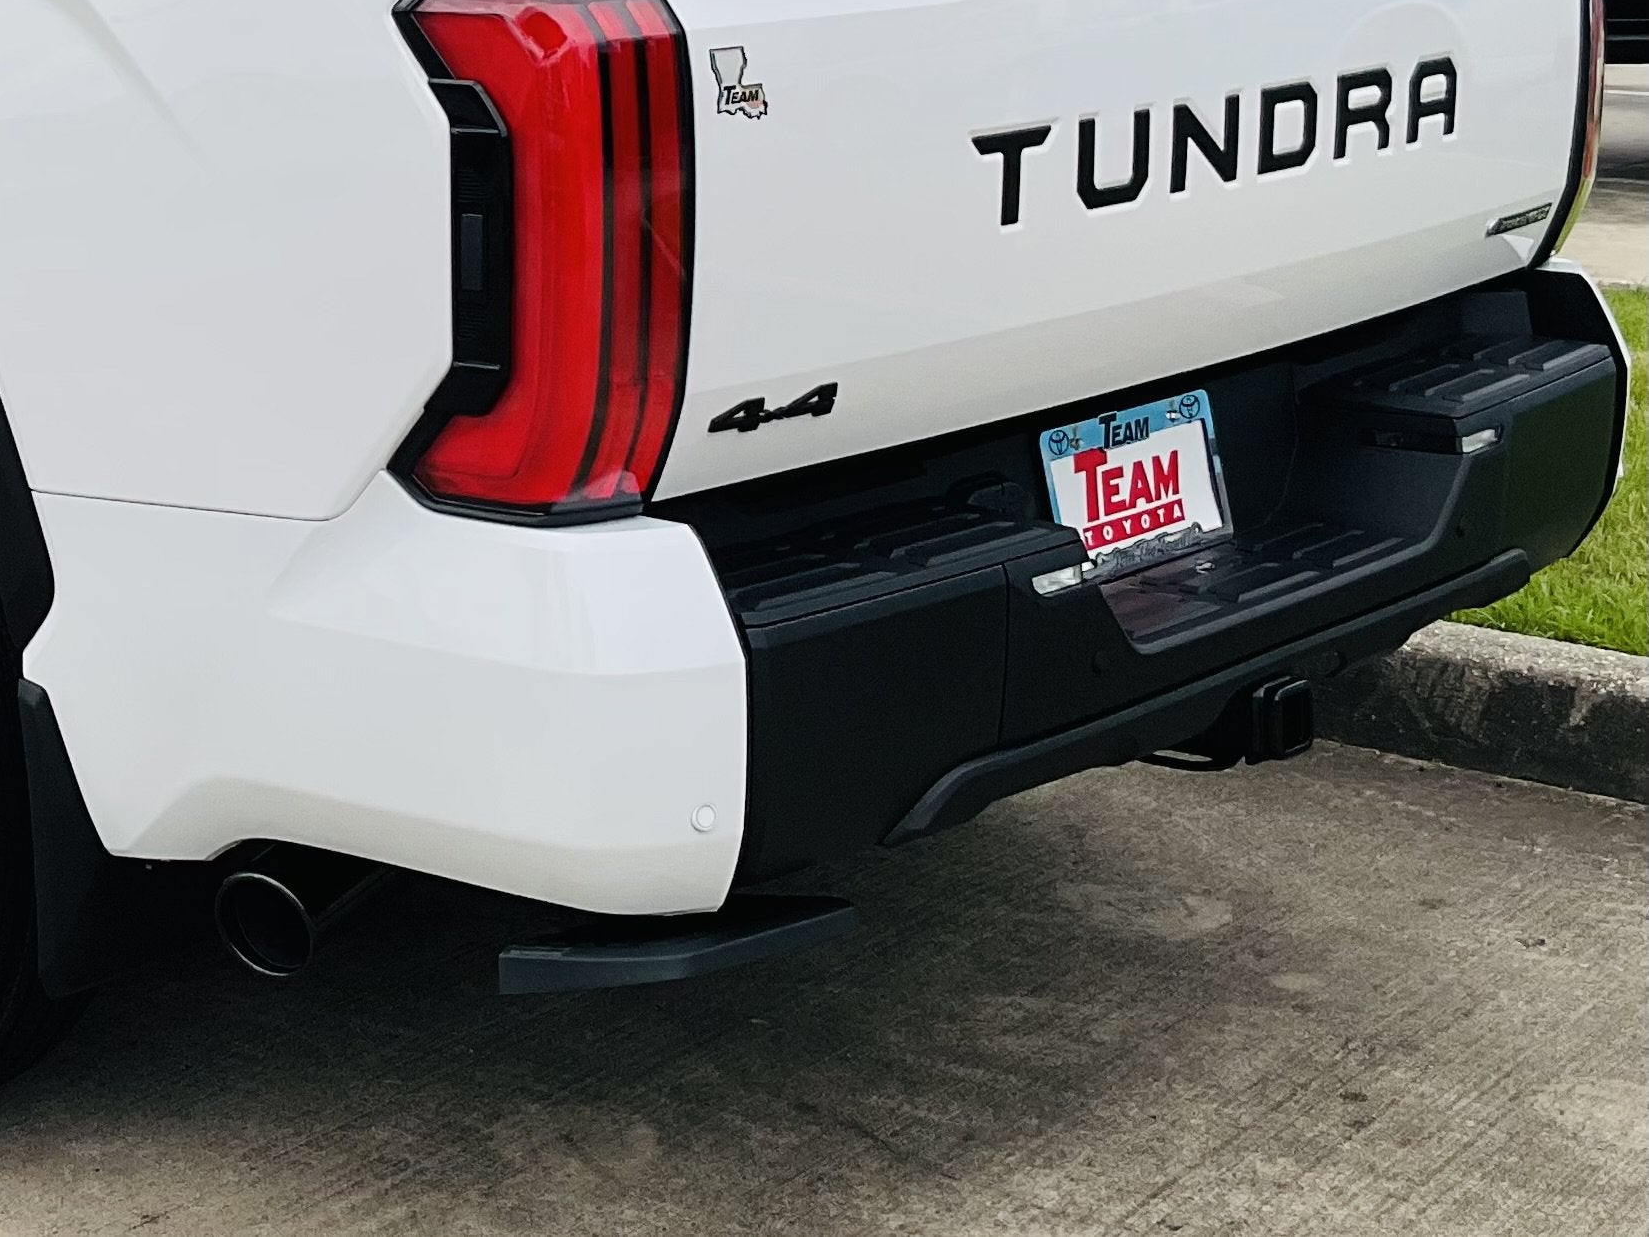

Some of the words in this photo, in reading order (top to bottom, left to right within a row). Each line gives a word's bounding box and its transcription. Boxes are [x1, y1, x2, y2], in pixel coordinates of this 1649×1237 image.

[722, 84, 760, 106] TEAM
[970, 55, 1458, 227] TUNDRA
[1098, 411, 1151, 450] TEAM
[1072, 447, 1181, 524] TEAM
[1083, 503, 1183, 547] TOYOTA
